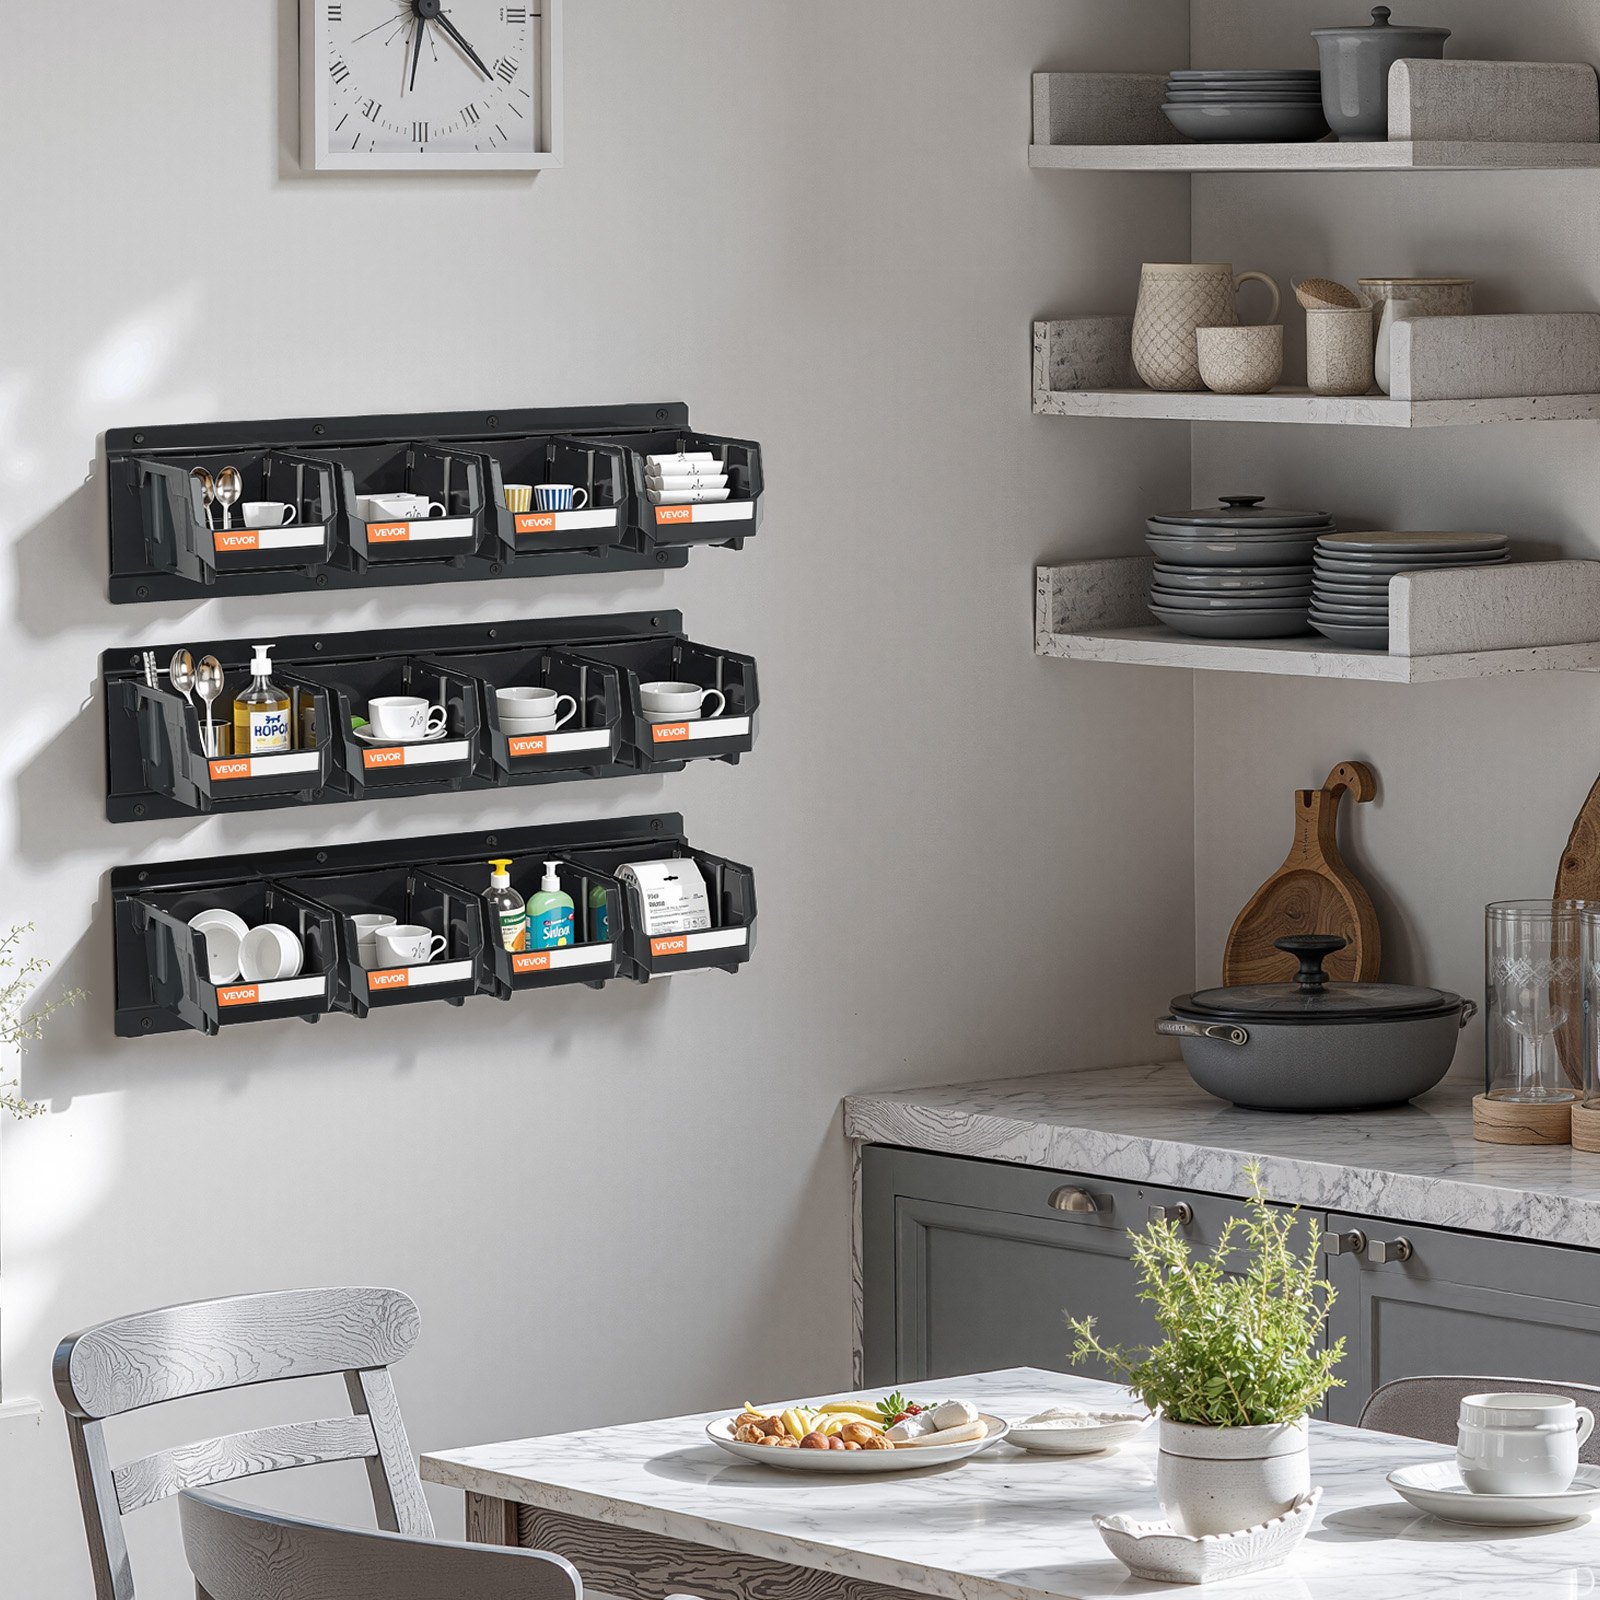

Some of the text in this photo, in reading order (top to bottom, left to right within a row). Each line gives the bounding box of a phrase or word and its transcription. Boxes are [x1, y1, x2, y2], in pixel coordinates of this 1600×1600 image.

[659, 509, 689, 519] VEVOR
[521, 518, 552, 527] VEVOR
[374, 527, 406, 537] VEVOR
[222, 536, 256, 546] VEVOR
[656, 727, 686, 737] VEVOR
[513, 740, 544, 750] VEVOR
[369, 752, 401, 762] VEVOR
[214, 763, 248, 774] VEVOR
[655, 940, 684, 951] VEVOR
[517, 957, 547, 967] VEVOR
[374, 974, 405, 984] VEVOR
[223, 990, 256, 1000] VEVOR
